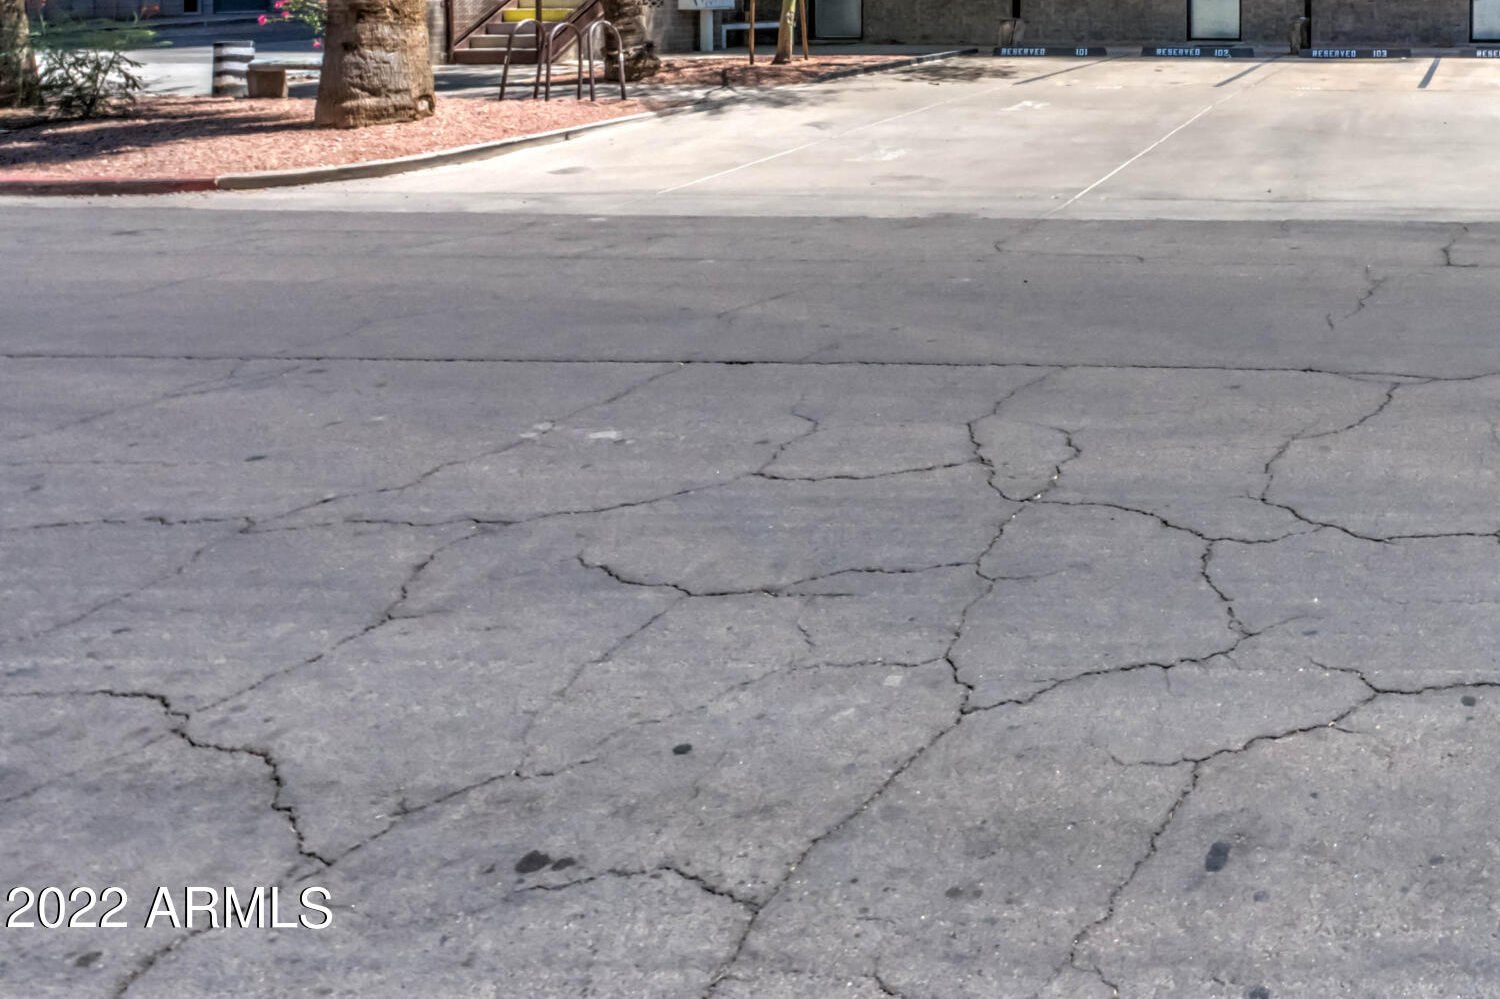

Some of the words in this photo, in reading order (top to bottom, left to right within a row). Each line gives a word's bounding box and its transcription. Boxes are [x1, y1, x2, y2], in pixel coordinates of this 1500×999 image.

[1000, 48, 1046, 56] RESERVED
[1156, 48, 1201, 56] RESERVED
[1214, 48, 1229, 56] 102
[1312, 49, 1357, 58] RESERVED
[1373, 50, 1388, 58] 103
